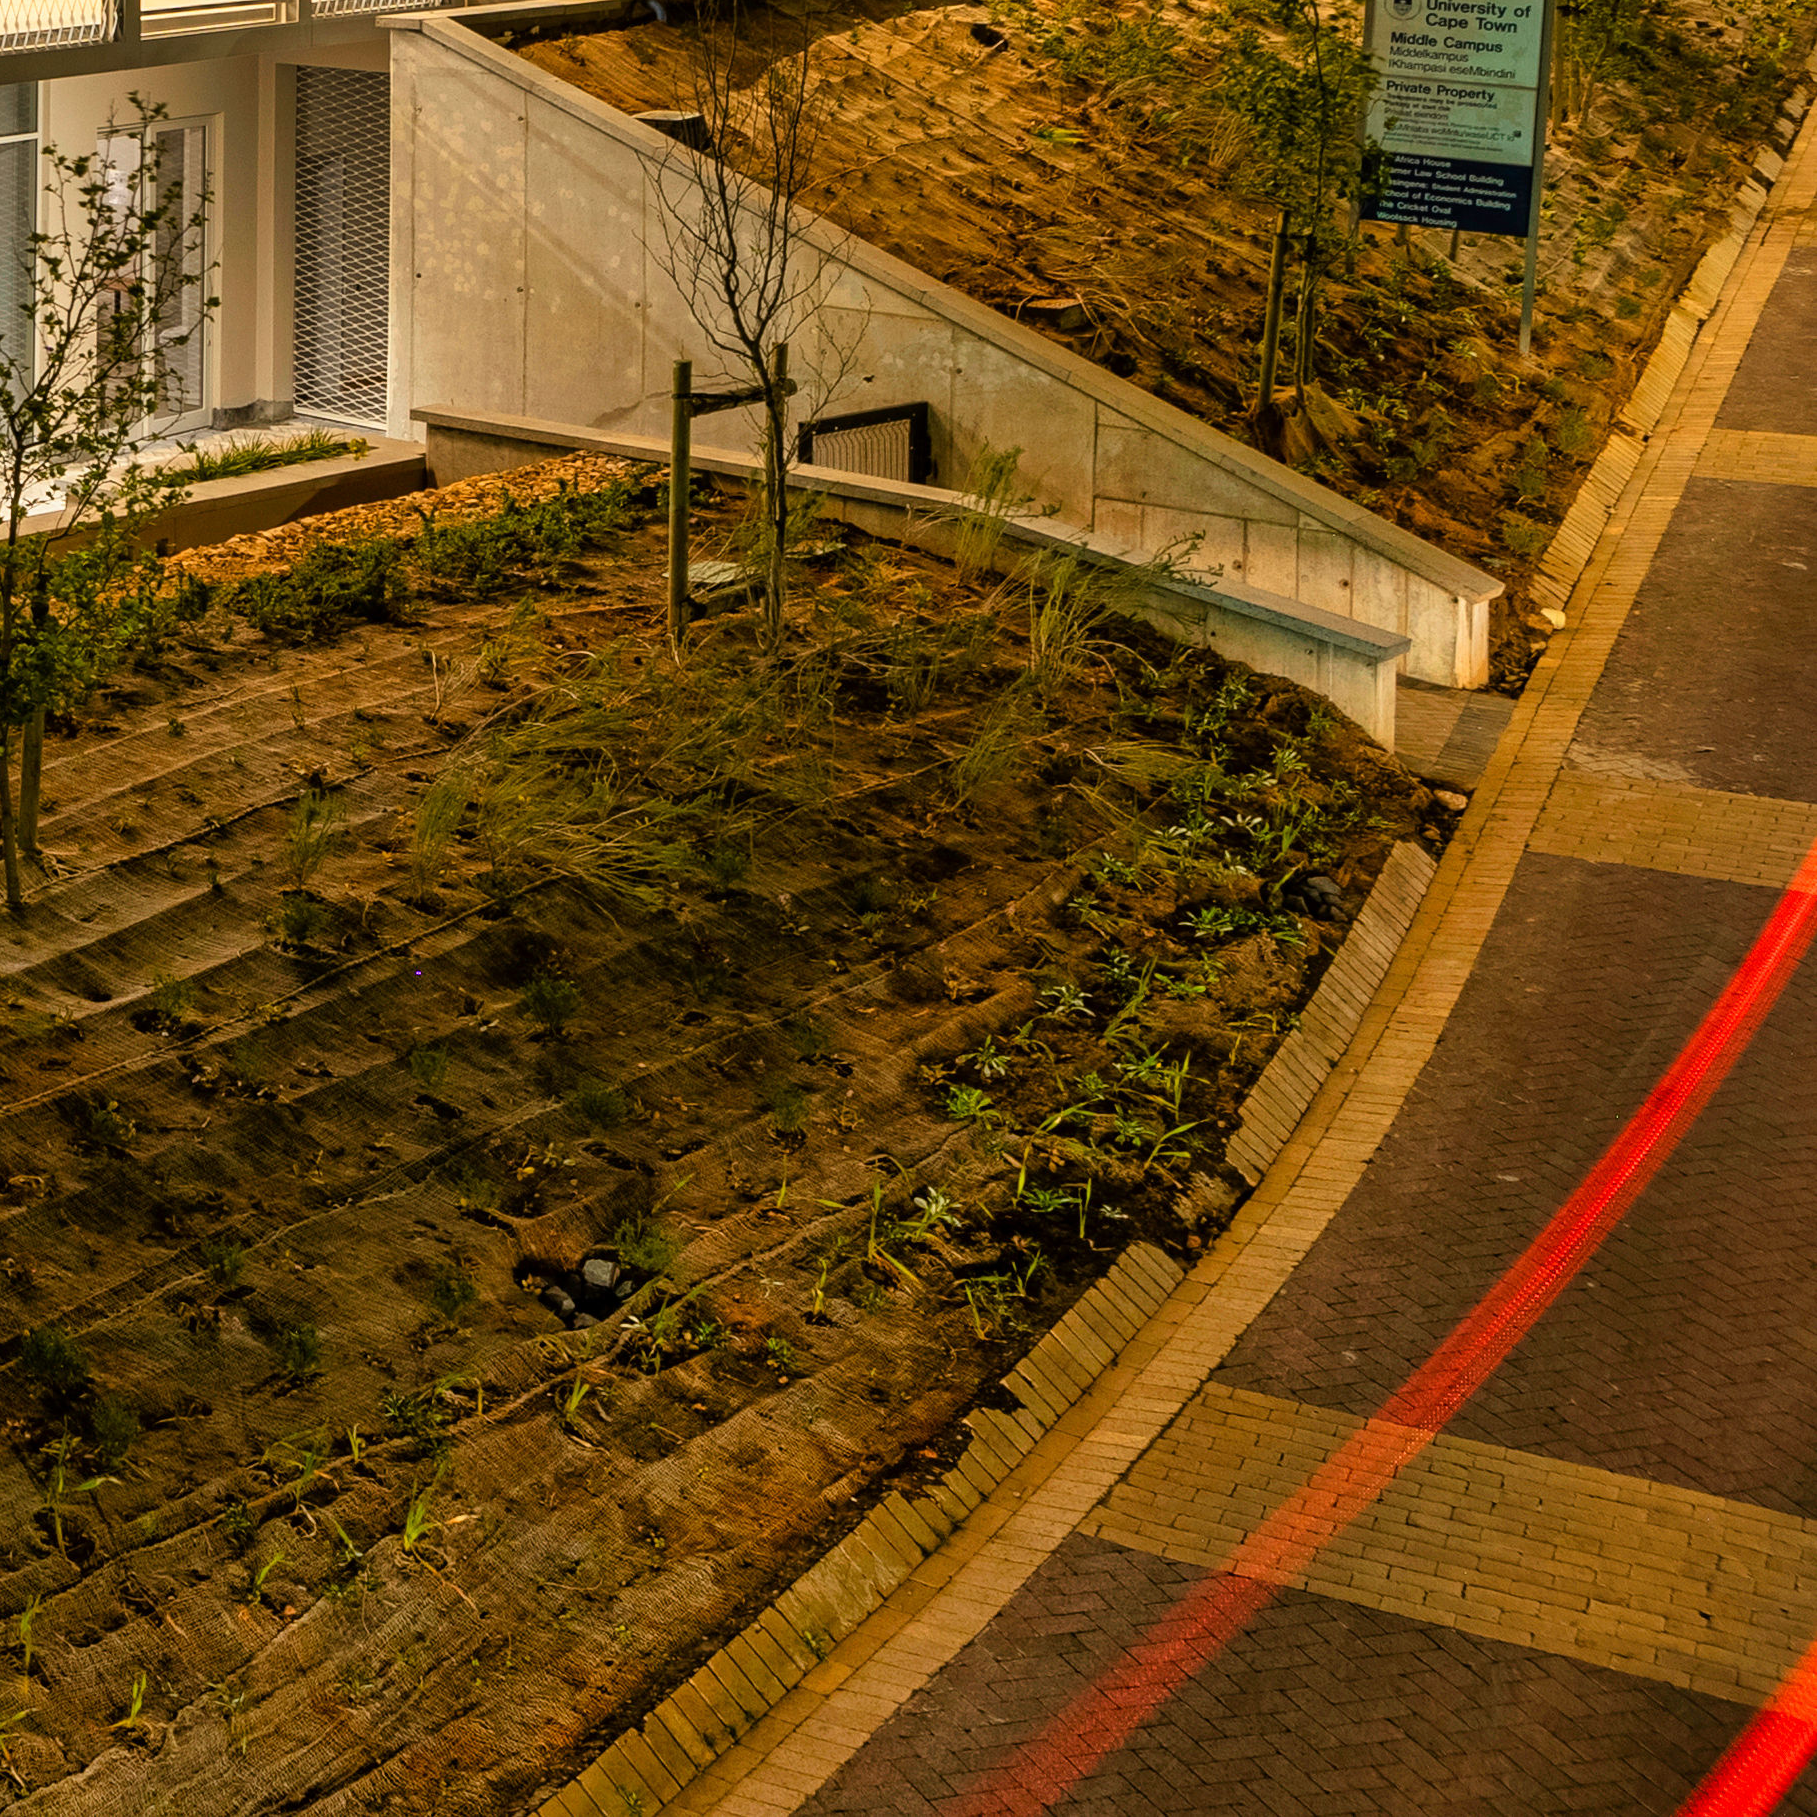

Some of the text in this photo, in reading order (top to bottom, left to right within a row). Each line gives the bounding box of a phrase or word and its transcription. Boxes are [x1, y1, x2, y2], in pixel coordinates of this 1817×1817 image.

[1514, 5, 1531, 18] of
[1425, 12, 1518, 33] Cape Town
[1390, 32, 1503, 53] Middle Campus
[1389, 46, 1469, 63] Middelkampus
[1386, 80, 1496, 102] Private Property
[1394, 155, 1452, 168] Africa House
[1414, 168, 1432, 178] Law
[1435, 170, 1466, 181] School
[1469, 174, 1504, 187] Building
[1396, 201, 1428, 213] Cricket
[1431, 205, 1452, 215] Oval
[1412, 192, 1421, 200] of
[1424, 193, 1473, 206] Economics
[1475, 198, 1512, 211] Building
[1421, 216, 1458, 228] Housing
